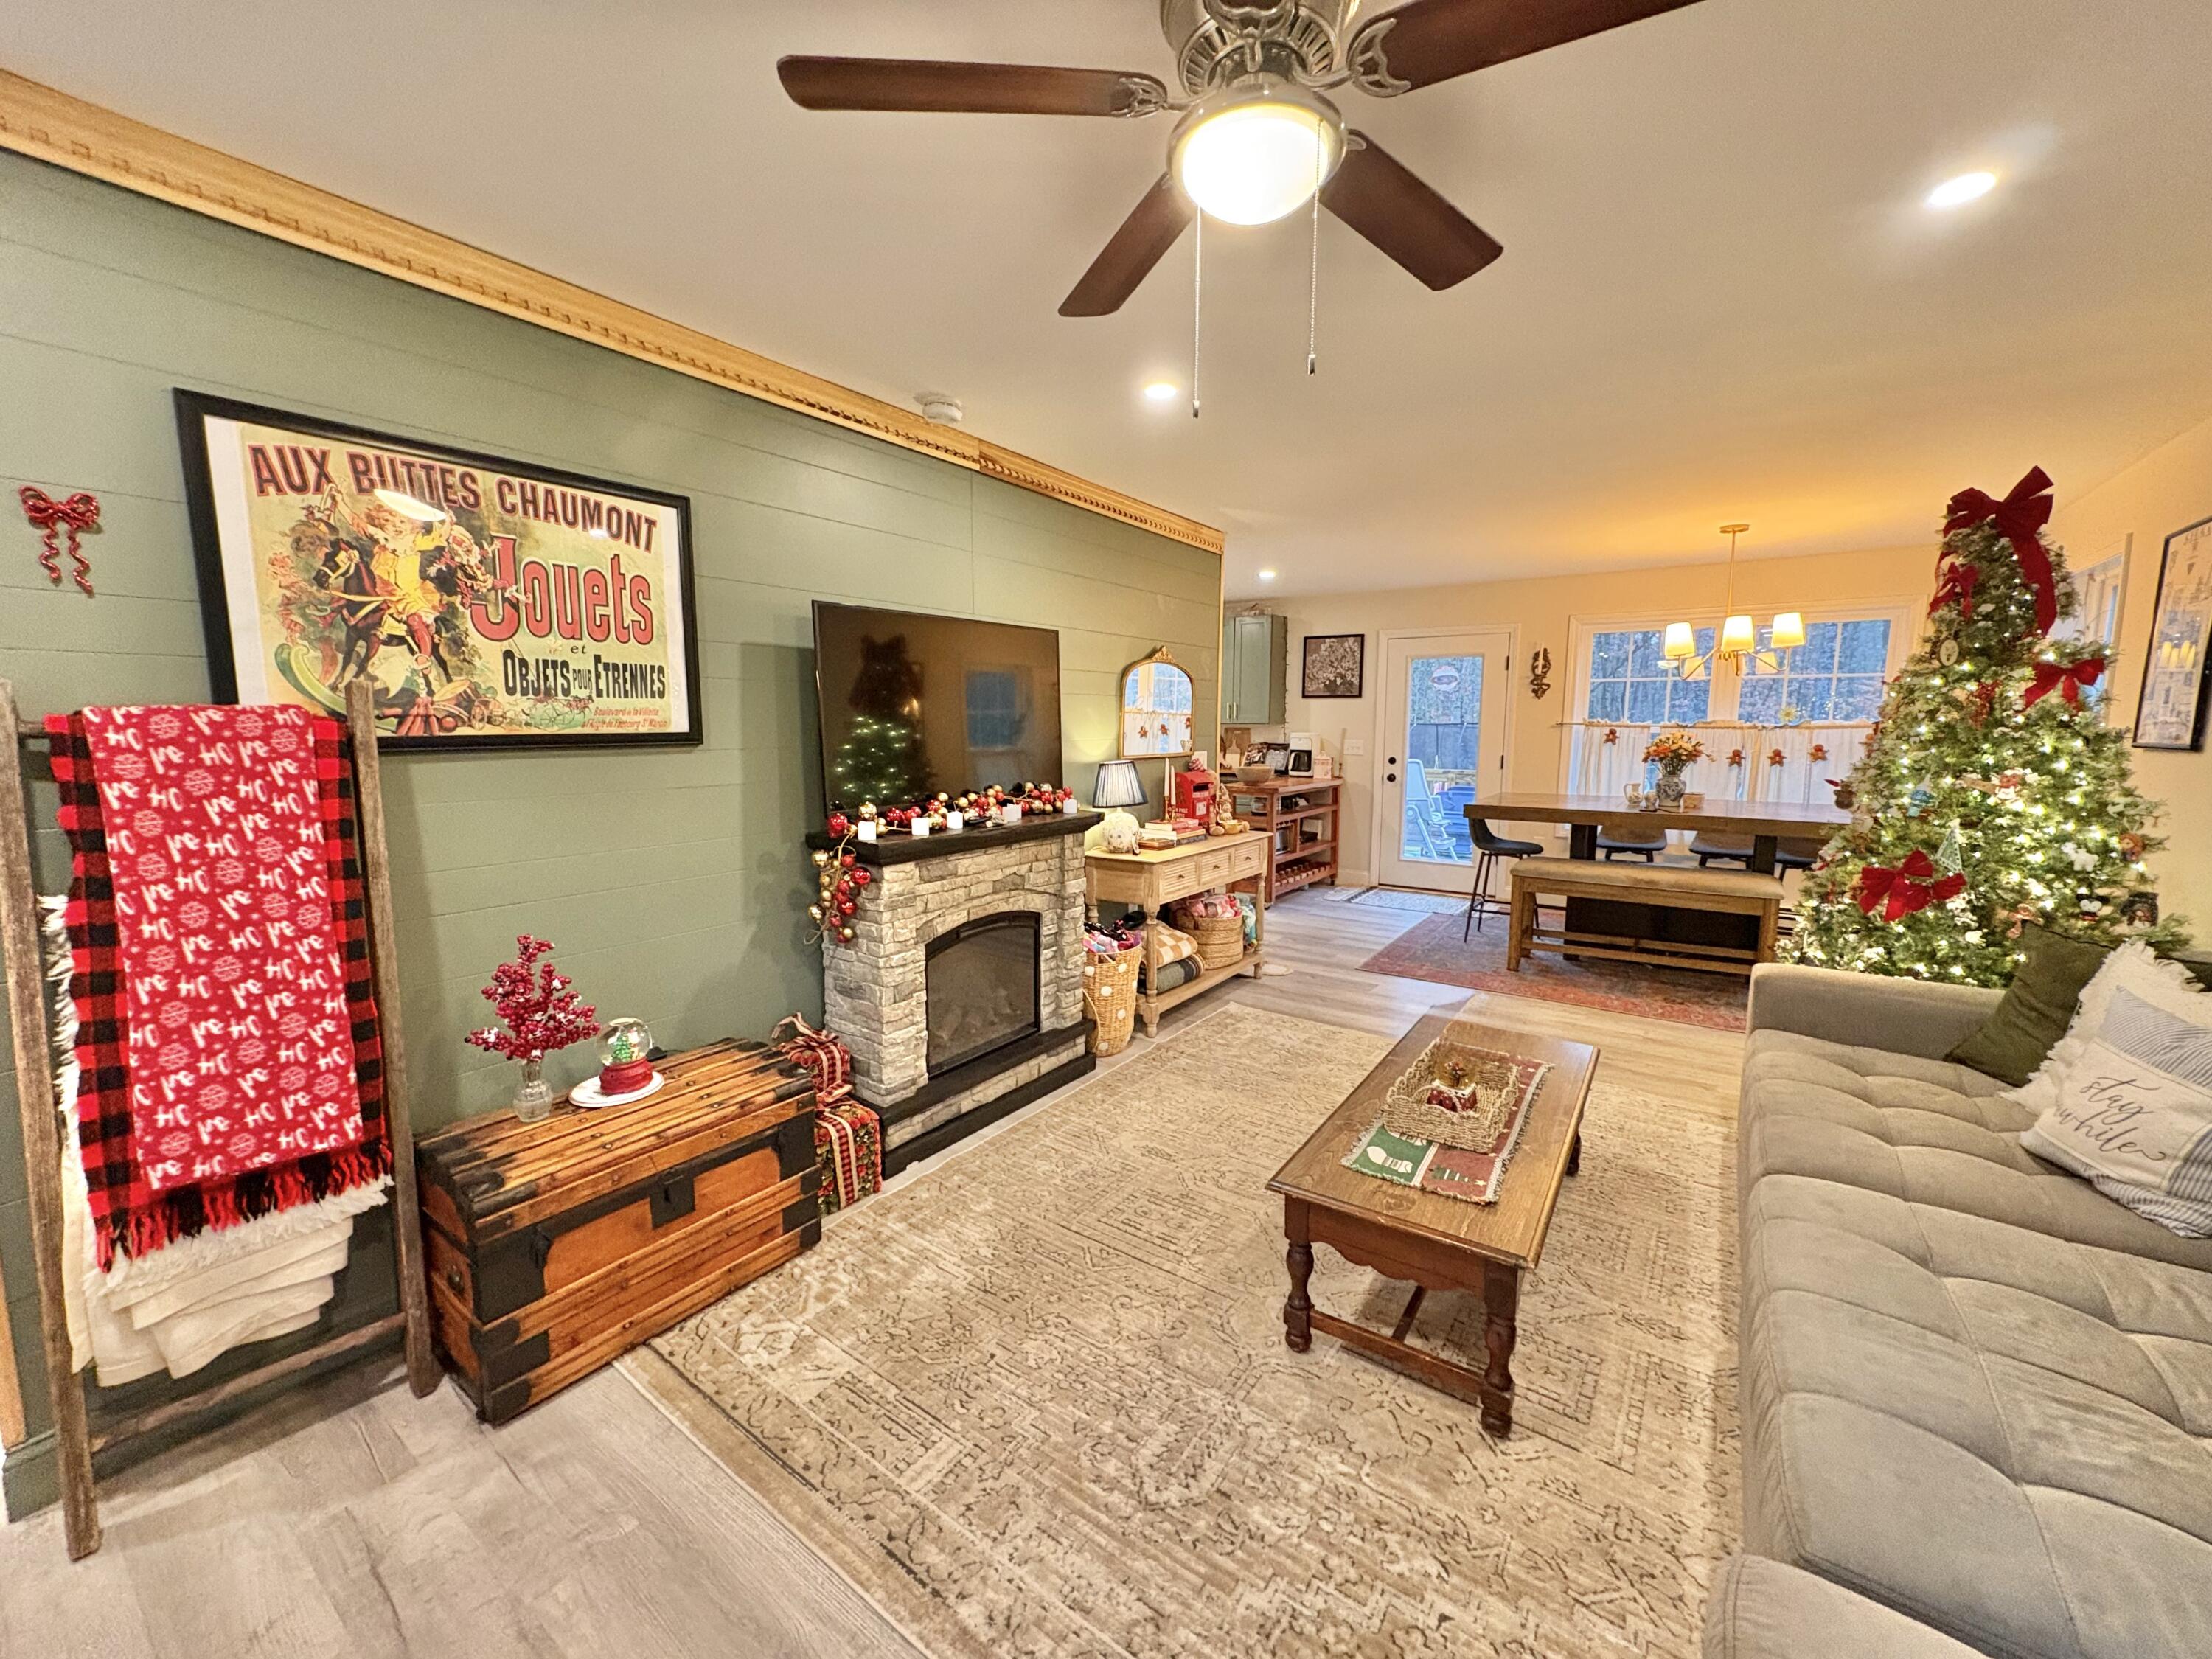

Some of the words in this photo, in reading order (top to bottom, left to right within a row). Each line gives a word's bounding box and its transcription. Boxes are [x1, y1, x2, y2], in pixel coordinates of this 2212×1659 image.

[248, 445, 338, 497] AUX
[347, 451, 482, 512] BUTTES
[495, 477, 658, 553] CHAUMONT
[470, 536, 654, 645] Jouets
[570, 645, 587, 655] et
[594, 654, 666, 700] ETRENNES
[2079, 1077, 2163, 1126] stay
